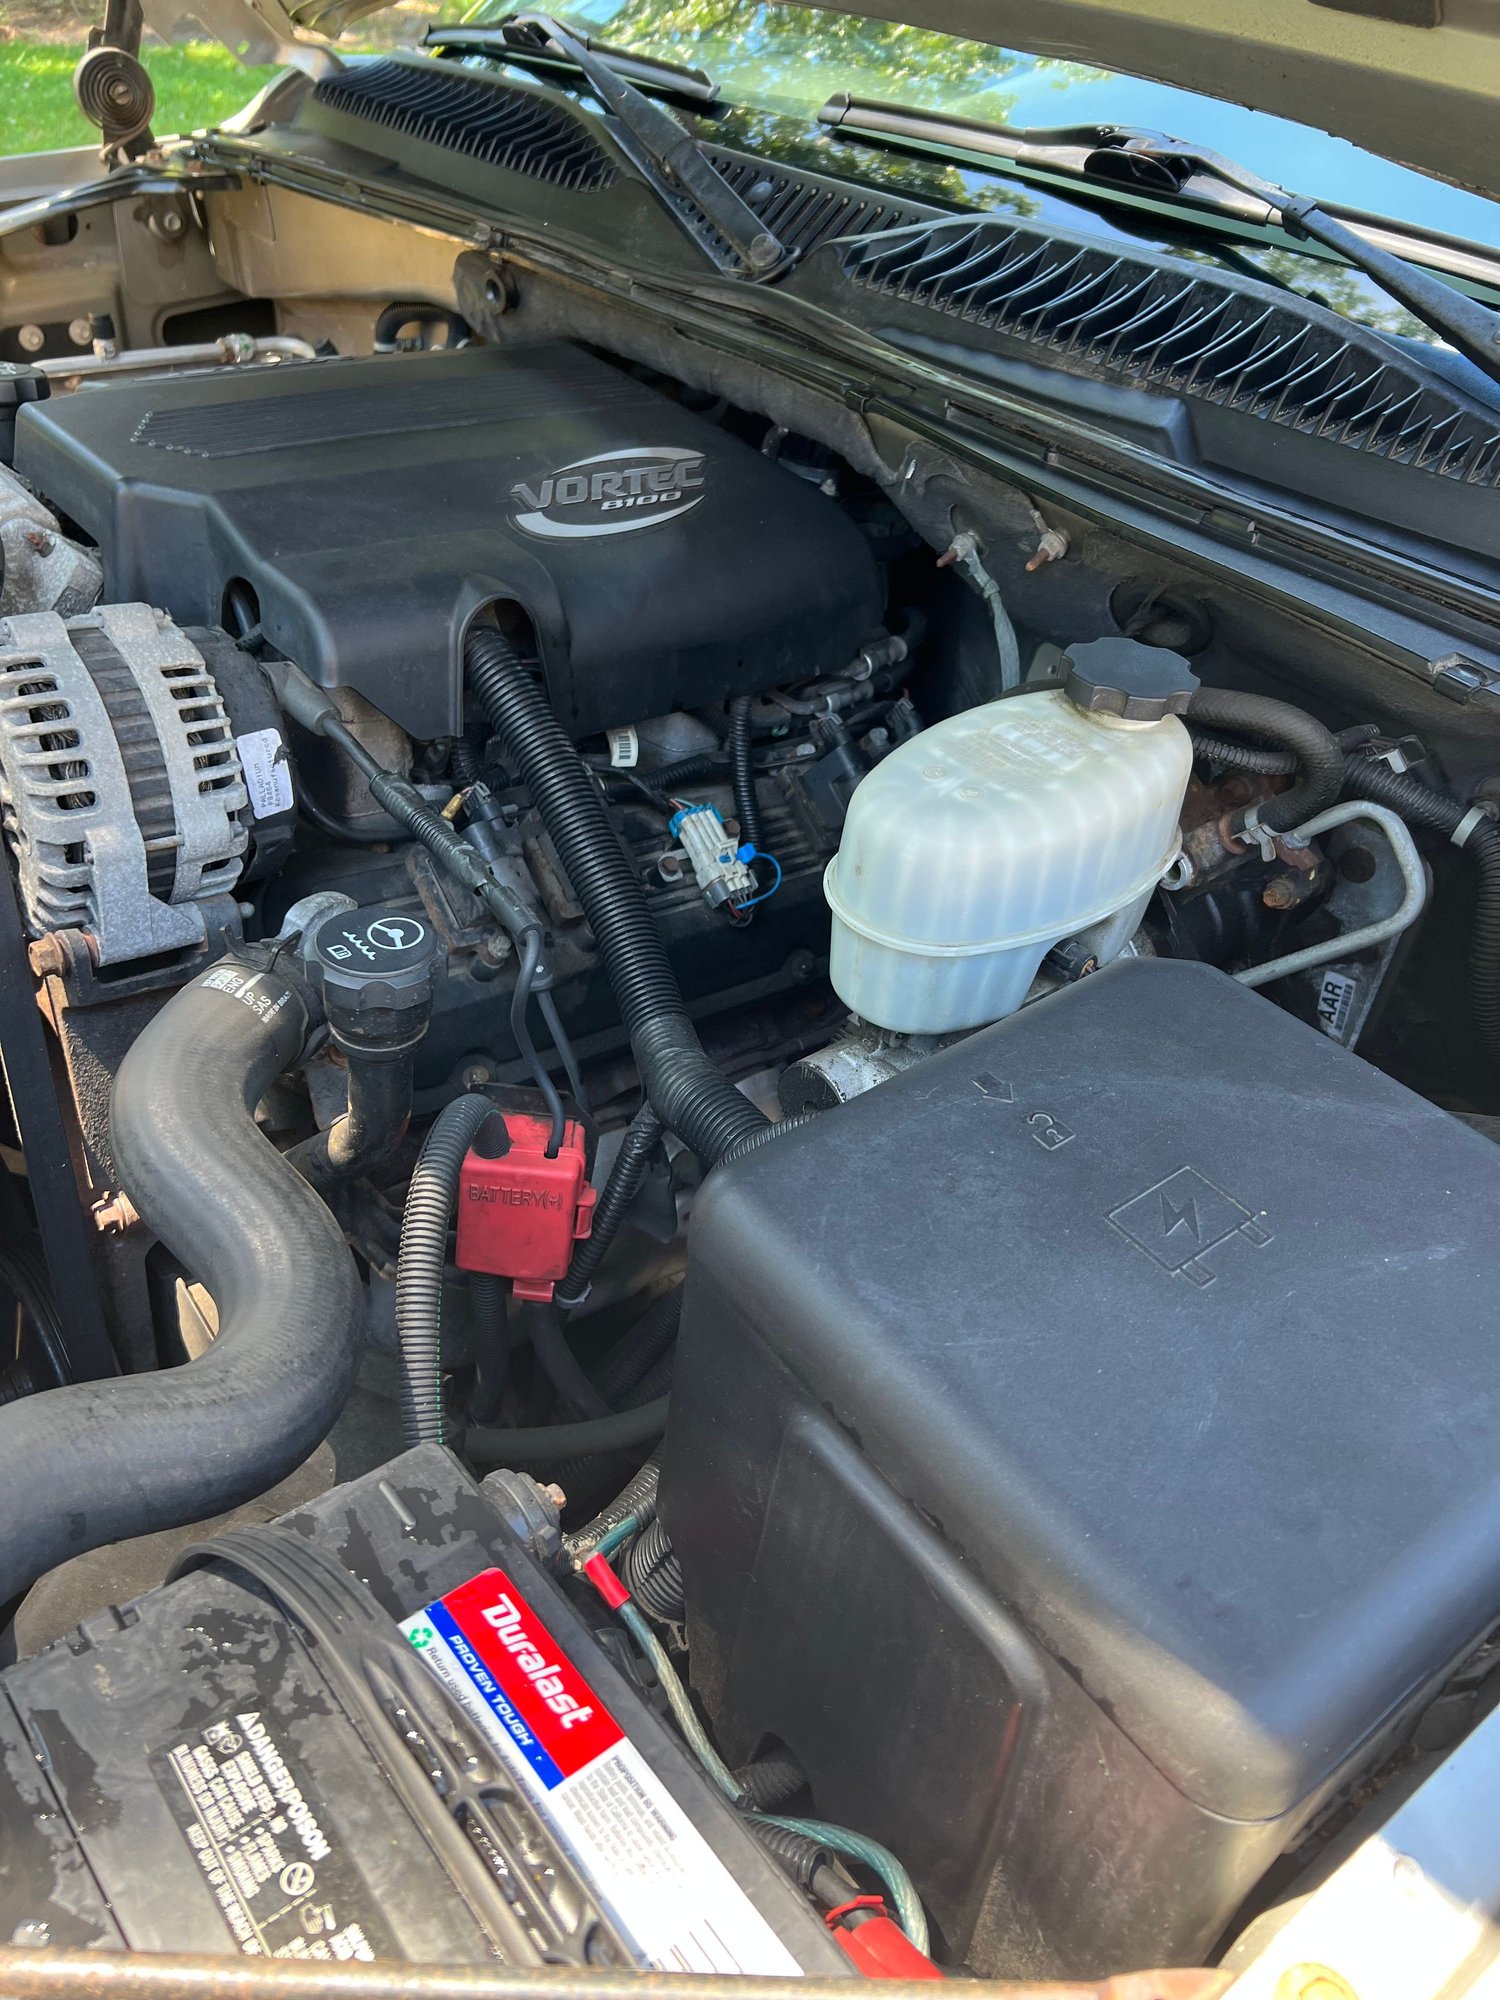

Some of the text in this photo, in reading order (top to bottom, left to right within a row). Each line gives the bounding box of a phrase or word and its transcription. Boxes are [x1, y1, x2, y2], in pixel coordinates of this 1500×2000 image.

[510, 460, 705, 509] VORTEC
[601, 491, 682, 511] 8100
[254, 762, 267, 808] PALLADIUM
[223, 977, 244, 994] ENG
[242, 991, 256, 1006] UP
[252, 995, 272, 1015] SAS
[1318, 981, 1343, 1024] AAR
[261, 1007, 276, 1023] MADE
[469, 1183, 564, 1210] BATTERY(+)
[426, 1646, 450, 1680] Return
[446, 1676, 465, 1703] used
[480, 1593, 594, 1729] Duralast
[448, 1635, 535, 1746] PROVEN TOUGH
[172, 1744, 208, 1795] BLINDNESS
[192, 1745, 245, 1830] GASES CAN CAUSE
[219, 1759, 258, 1814] EXPLOSIVE
[234, 1751, 277, 1812] SHIELD EYES
[244, 1722, 332, 1862] DANGER/POISON
[185, 1823, 210, 1849] KEEP
[269, 1815, 288, 1834] NO
[197, 1848, 219, 1871] OUT
[240, 1841, 272, 1883] FLAMES
[255, 1832, 287, 1873] SPARKS
[214, 1882, 237, 1908] THE
[226, 1850, 261, 1899] SMOKING
[224, 1902, 253, 1942] REACH
